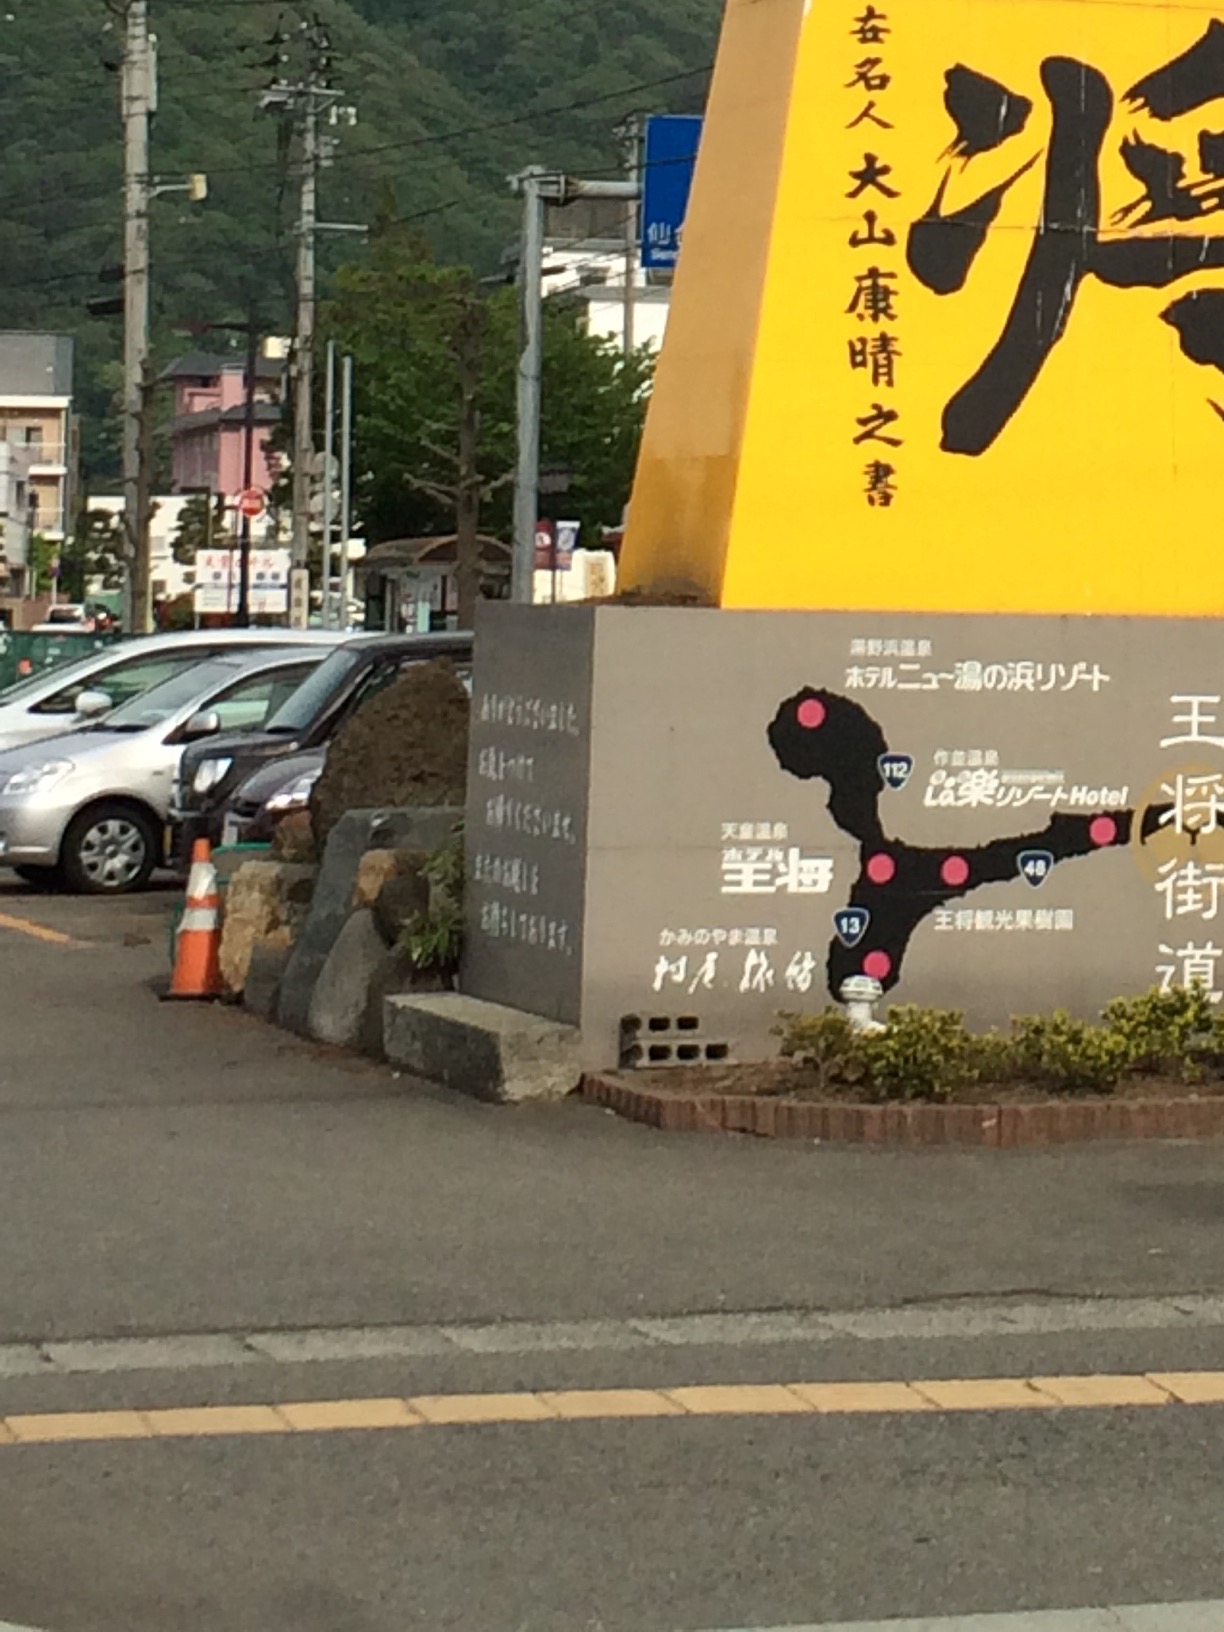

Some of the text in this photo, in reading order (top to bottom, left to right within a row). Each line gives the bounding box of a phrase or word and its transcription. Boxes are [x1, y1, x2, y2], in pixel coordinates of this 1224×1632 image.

[883, 762, 908, 778] 112
[721, 822, 787, 840] 天童温泉
[721, 847, 833, 893] 王将
[1024, 859, 1046, 876] 48
[841, 917, 860, 934] 13
[659, 929, 777, 945] かみのやま温泉
